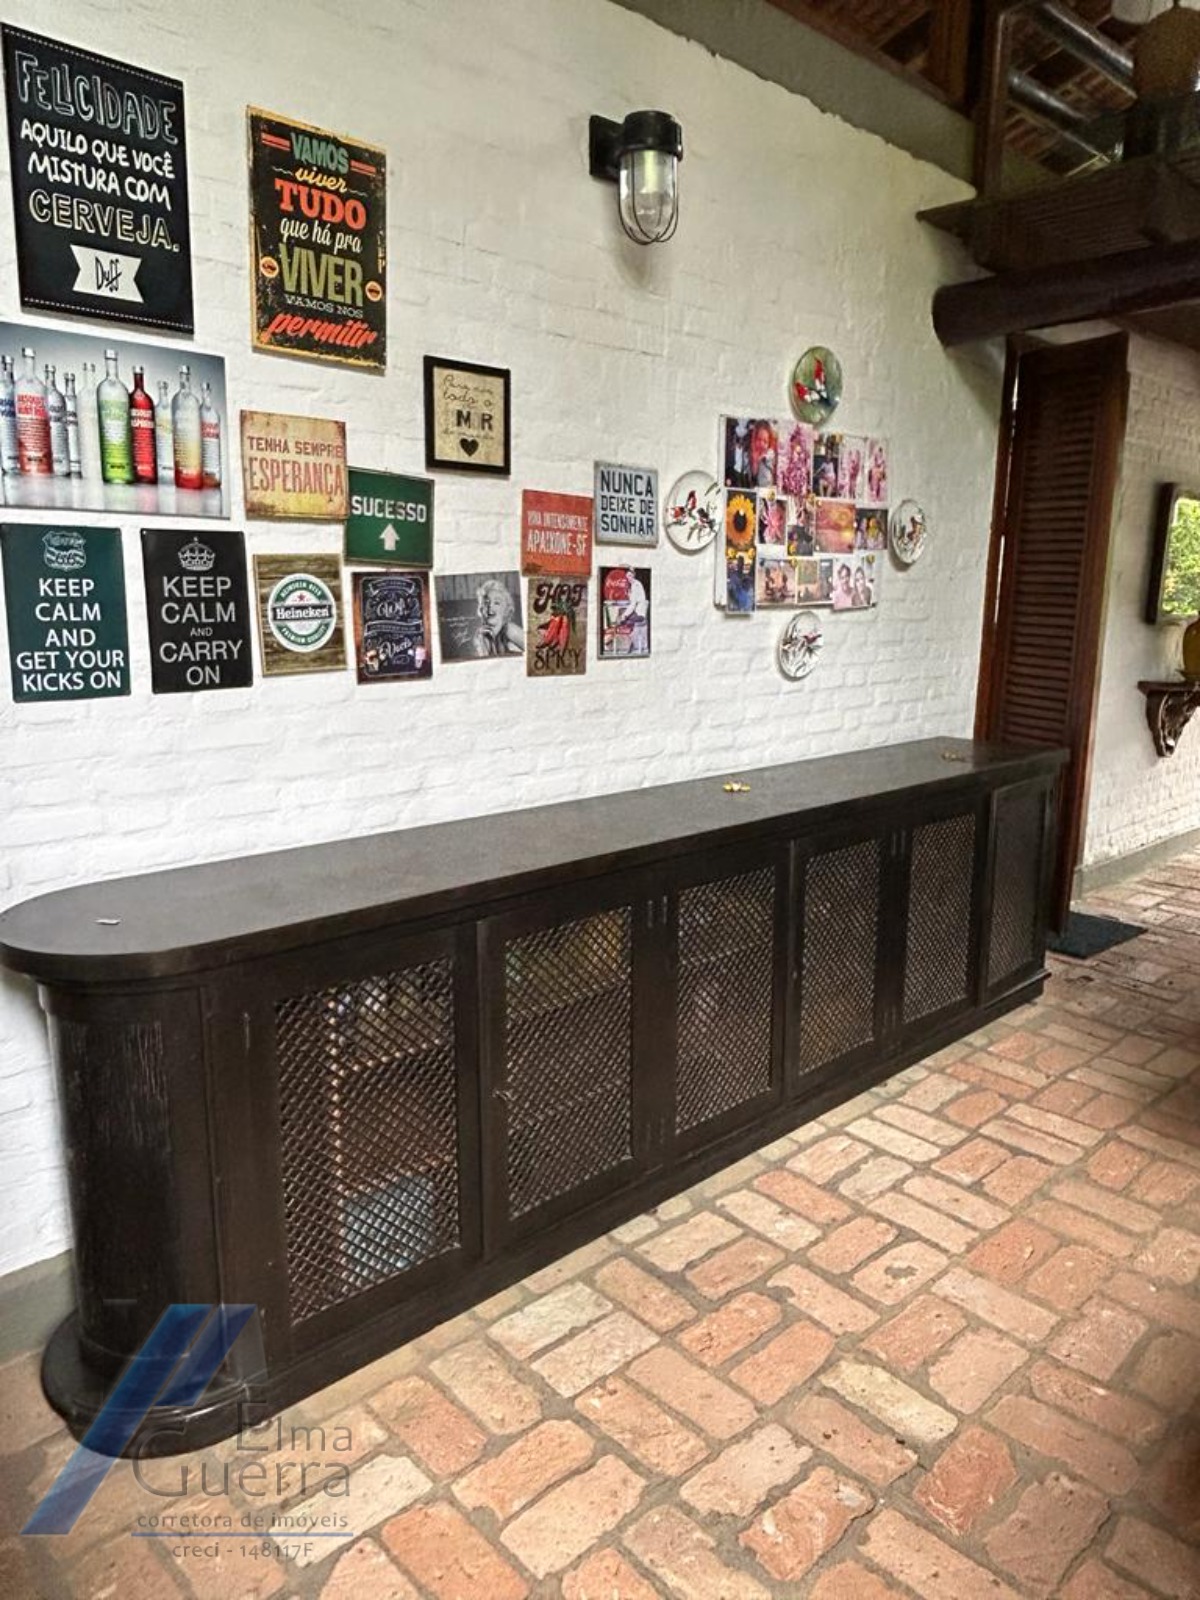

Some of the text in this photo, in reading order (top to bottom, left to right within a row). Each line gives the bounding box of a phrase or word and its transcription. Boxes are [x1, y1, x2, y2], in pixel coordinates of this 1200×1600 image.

[15, 51, 178, 144] FELICIDADE
[21, 118, 175, 179] AQUILO QUE VOCÊ
[290, 132, 349, 174] VAMOS
[28, 152, 171, 211] MISTURA COM
[295, 166, 348, 193] viver
[275, 178, 367, 230] TUDO
[29, 189, 180, 252] CERVEJA.
[280, 217, 362, 255] que há pra
[278, 243, 363, 307] VIVER
[284, 294, 363, 319] VAMOS NOS
[247, 435, 290, 454] TENHA
[600, 469, 654, 497] NUNCA
[351, 495, 427, 523] SUCESSO
[600, 495, 655, 516] DEIXE DE
[601, 514, 654, 537] SONHAR
[38, 577, 95, 597] KEEP
[162, 576, 232, 598] KEEP
[35, 602, 101, 622] CALM
[160, 601, 236, 624] CALM
[276, 606, 329, 620] Heineken
[44, 628, 96, 647] AND
[189, 627, 213, 637] AND
[16, 649, 125, 670] GET YOUR
[159, 640, 243, 663] CARRY
[21, 670, 122, 692] KICKS ON
[186, 665, 221, 686] ON
